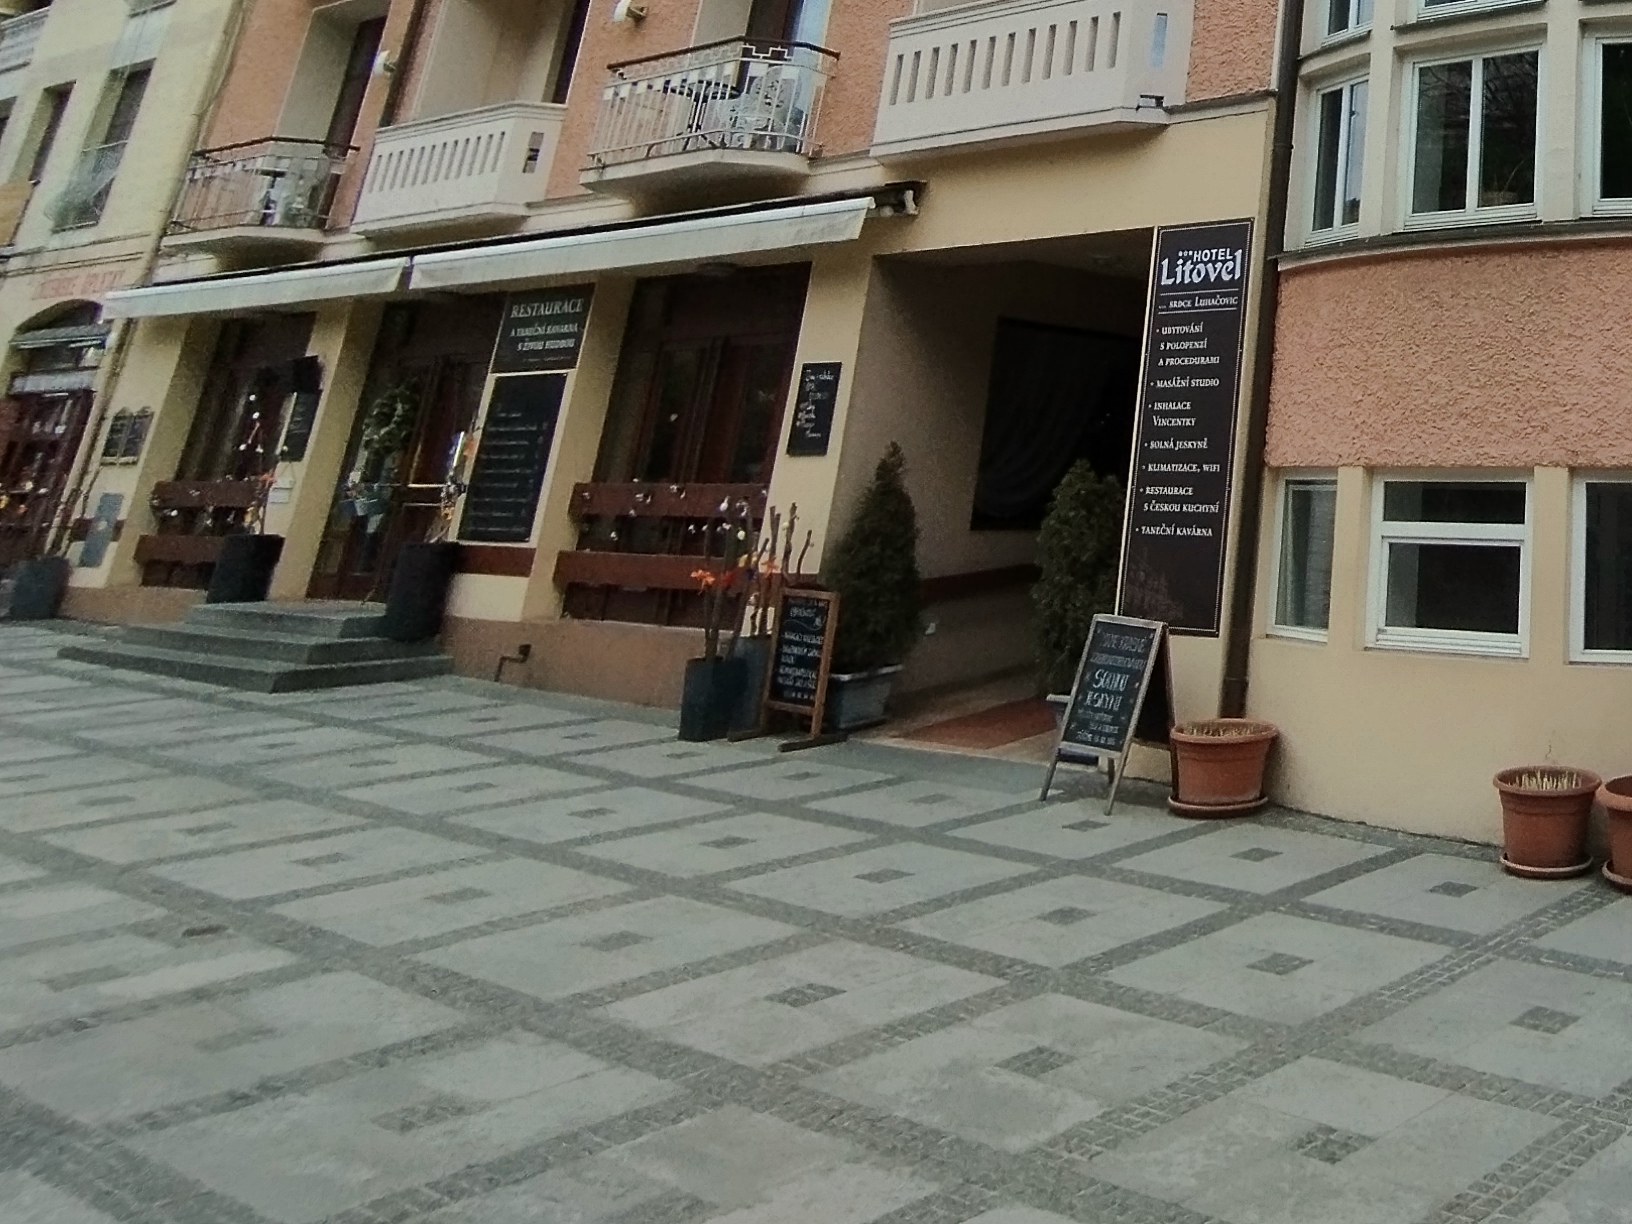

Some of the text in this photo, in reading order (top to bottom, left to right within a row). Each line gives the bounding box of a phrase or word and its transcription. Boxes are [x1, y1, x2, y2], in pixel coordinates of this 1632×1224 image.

[1193, 248, 1233, 262] HOTEL
[1161, 249, 1242, 285] Litovel
[510, 298, 584, 318] RESTAURACE
[1161, 322, 1203, 335] UBYTOVÁNÍ
[1158, 356, 1220, 366] A PROCEDURAMI
[1156, 376, 1220, 388] MASÁŽNÍ STUDIO
[1154, 402, 1191, 410] INHALACE
[1150, 438, 1208, 450] SOLNÁ JESKYNĚ
[1145, 487, 1193, 495] RESTAURACE
[1150, 500, 1181, 512] ČESKOU
[1182, 501, 1219, 513] KUCHYNÍ
[1141, 524, 1213, 536] TANEČNÍ KAVÁRNA
